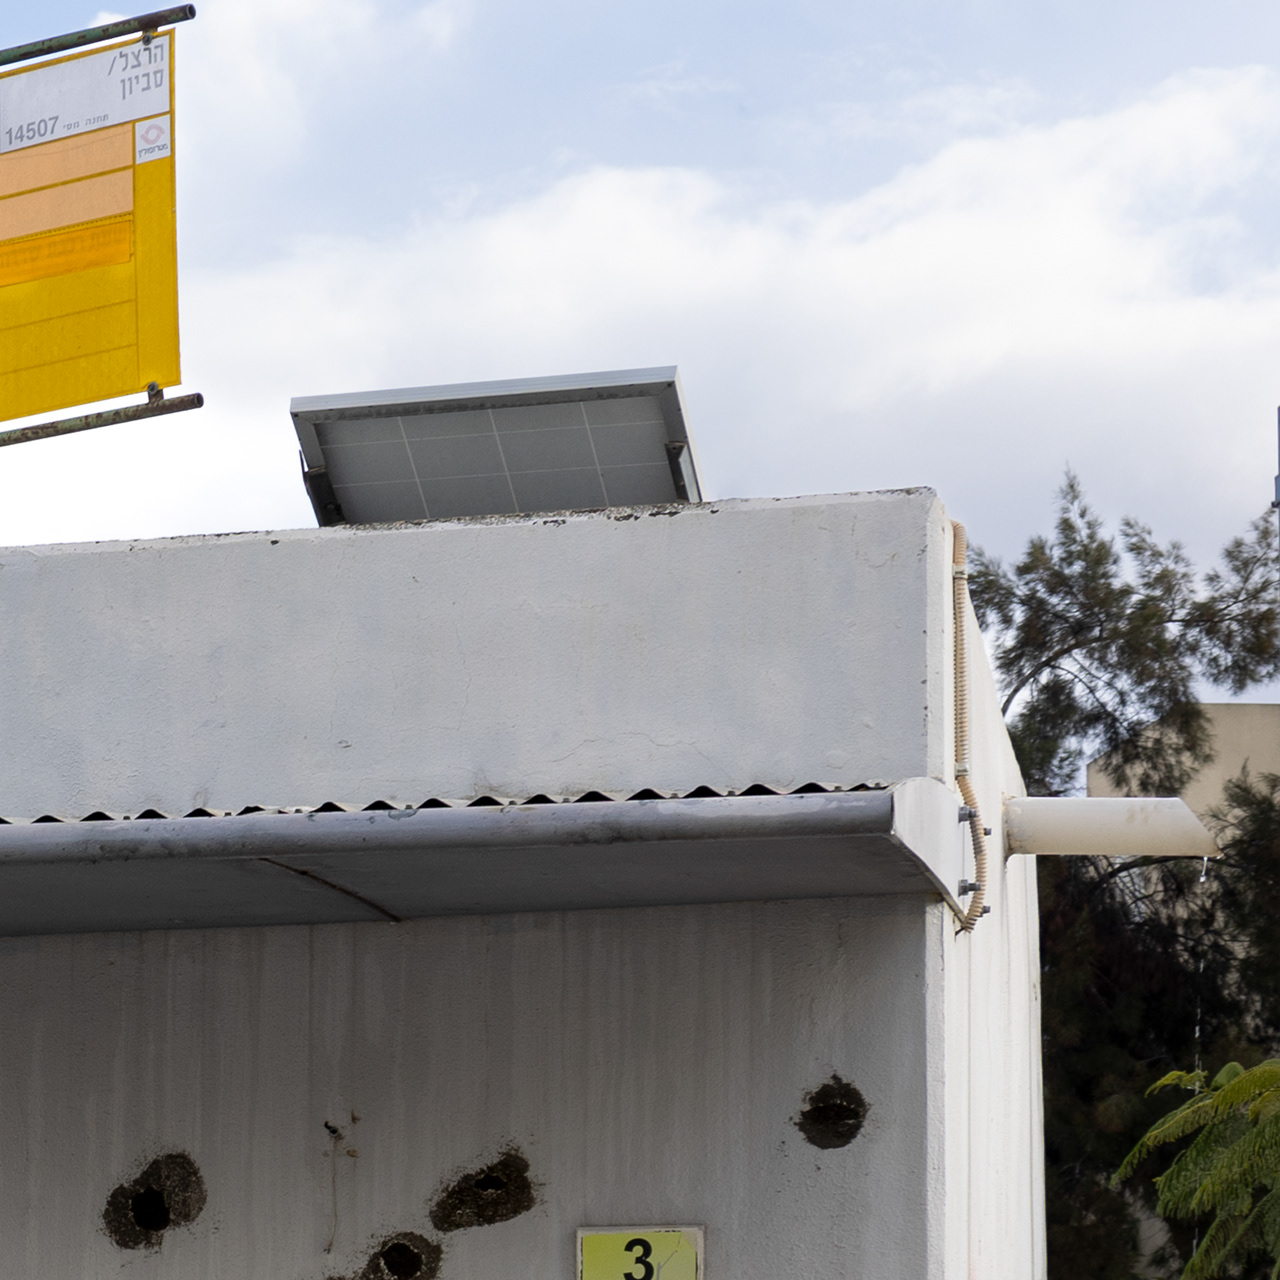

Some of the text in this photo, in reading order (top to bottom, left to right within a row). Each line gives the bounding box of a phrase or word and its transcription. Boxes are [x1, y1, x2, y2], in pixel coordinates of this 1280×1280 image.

[107, 43, 164, 76] הרצל/
[119, 69, 164, 100] סביון
[5, 115, 60, 146] 14507
[85, 113, 109, 127] תחנה
